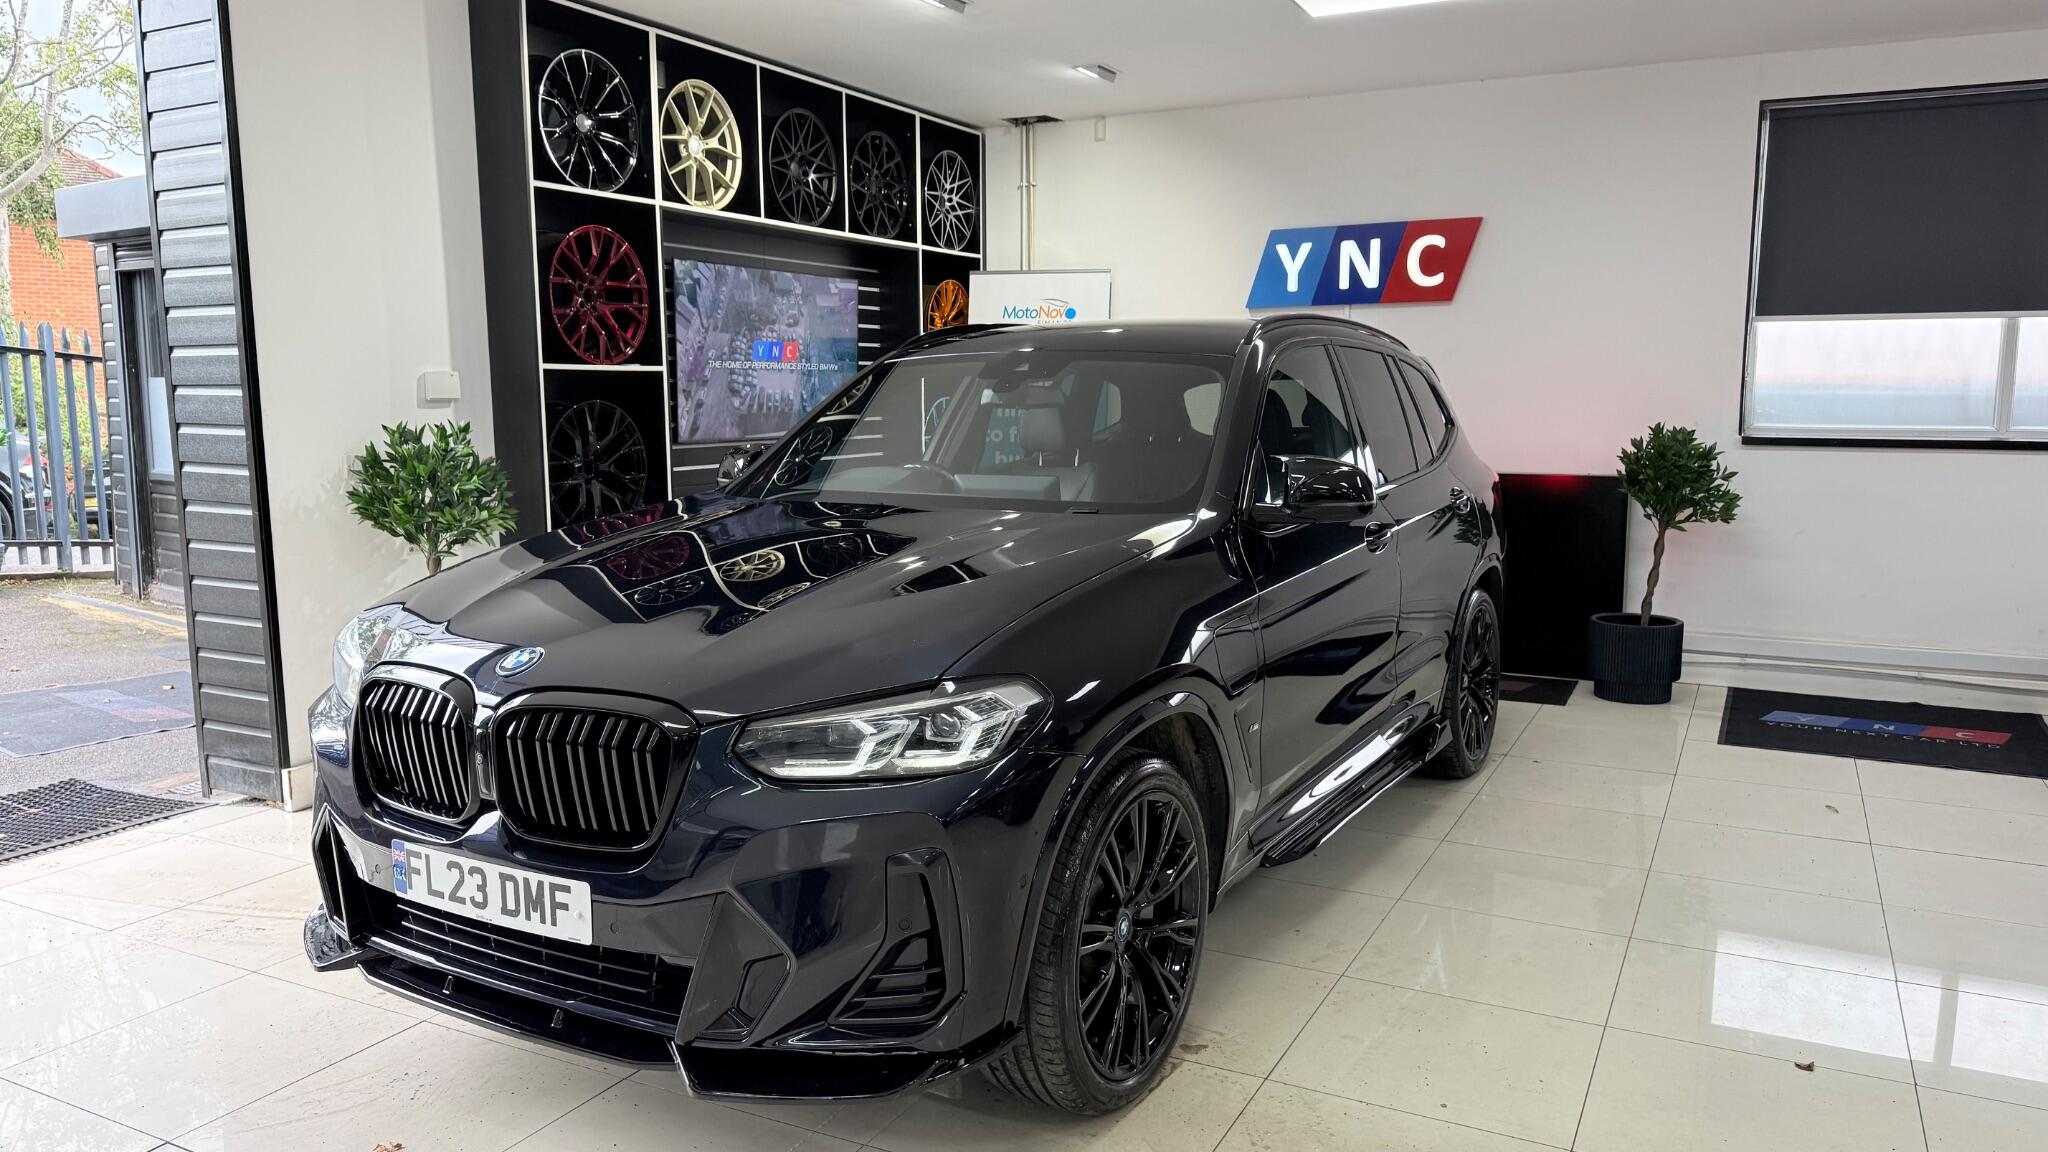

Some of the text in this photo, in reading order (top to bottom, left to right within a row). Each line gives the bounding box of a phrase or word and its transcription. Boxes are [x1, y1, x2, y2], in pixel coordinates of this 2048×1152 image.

[1275, 234, 1446, 292] YNC
[708, 360, 722, 369] THE
[722, 360, 743, 369] HOME
[743, 361, 752, 369] OF
[752, 361, 797, 370] PERFORMANCE
[757, 345, 793, 358] YNC
[405, 848, 572, 927] FL23 DMF
